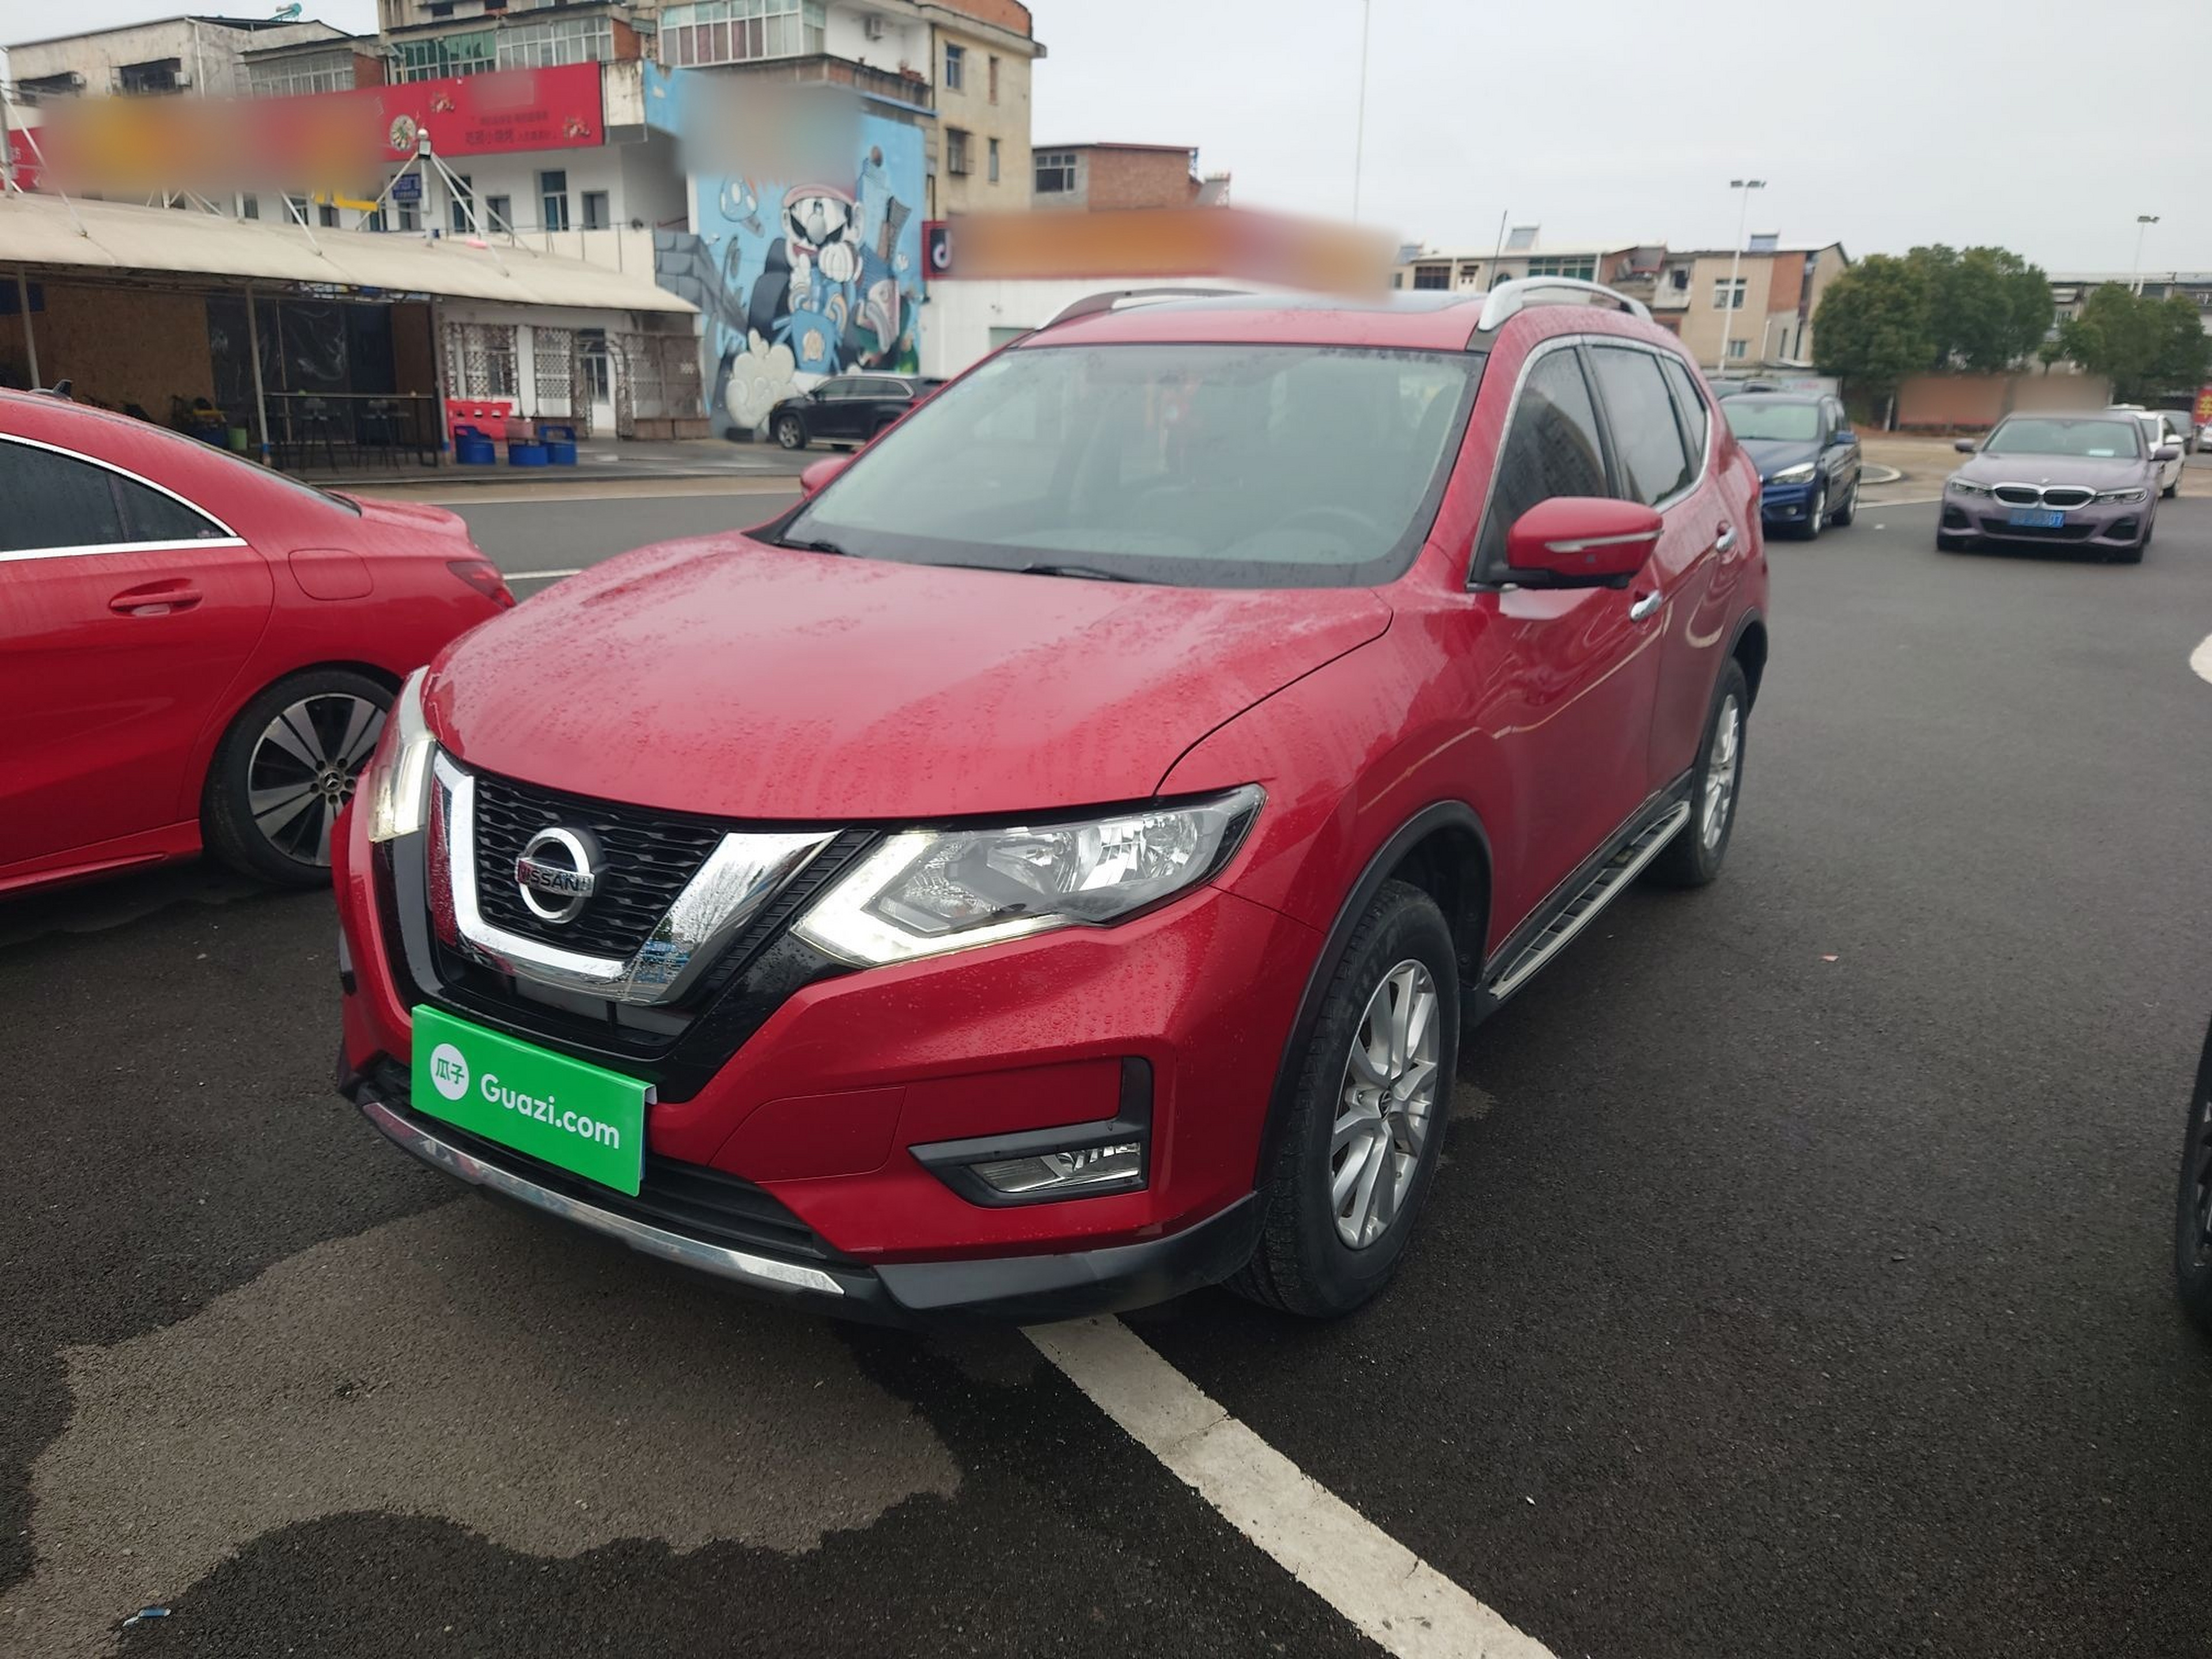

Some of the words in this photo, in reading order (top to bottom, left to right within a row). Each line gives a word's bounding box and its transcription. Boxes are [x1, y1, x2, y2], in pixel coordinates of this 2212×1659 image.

[519, 864, 579, 891] NISSAN
[435, 1058, 464, 1085] 瓜子
[480, 1074, 620, 1149] Guazi.com
